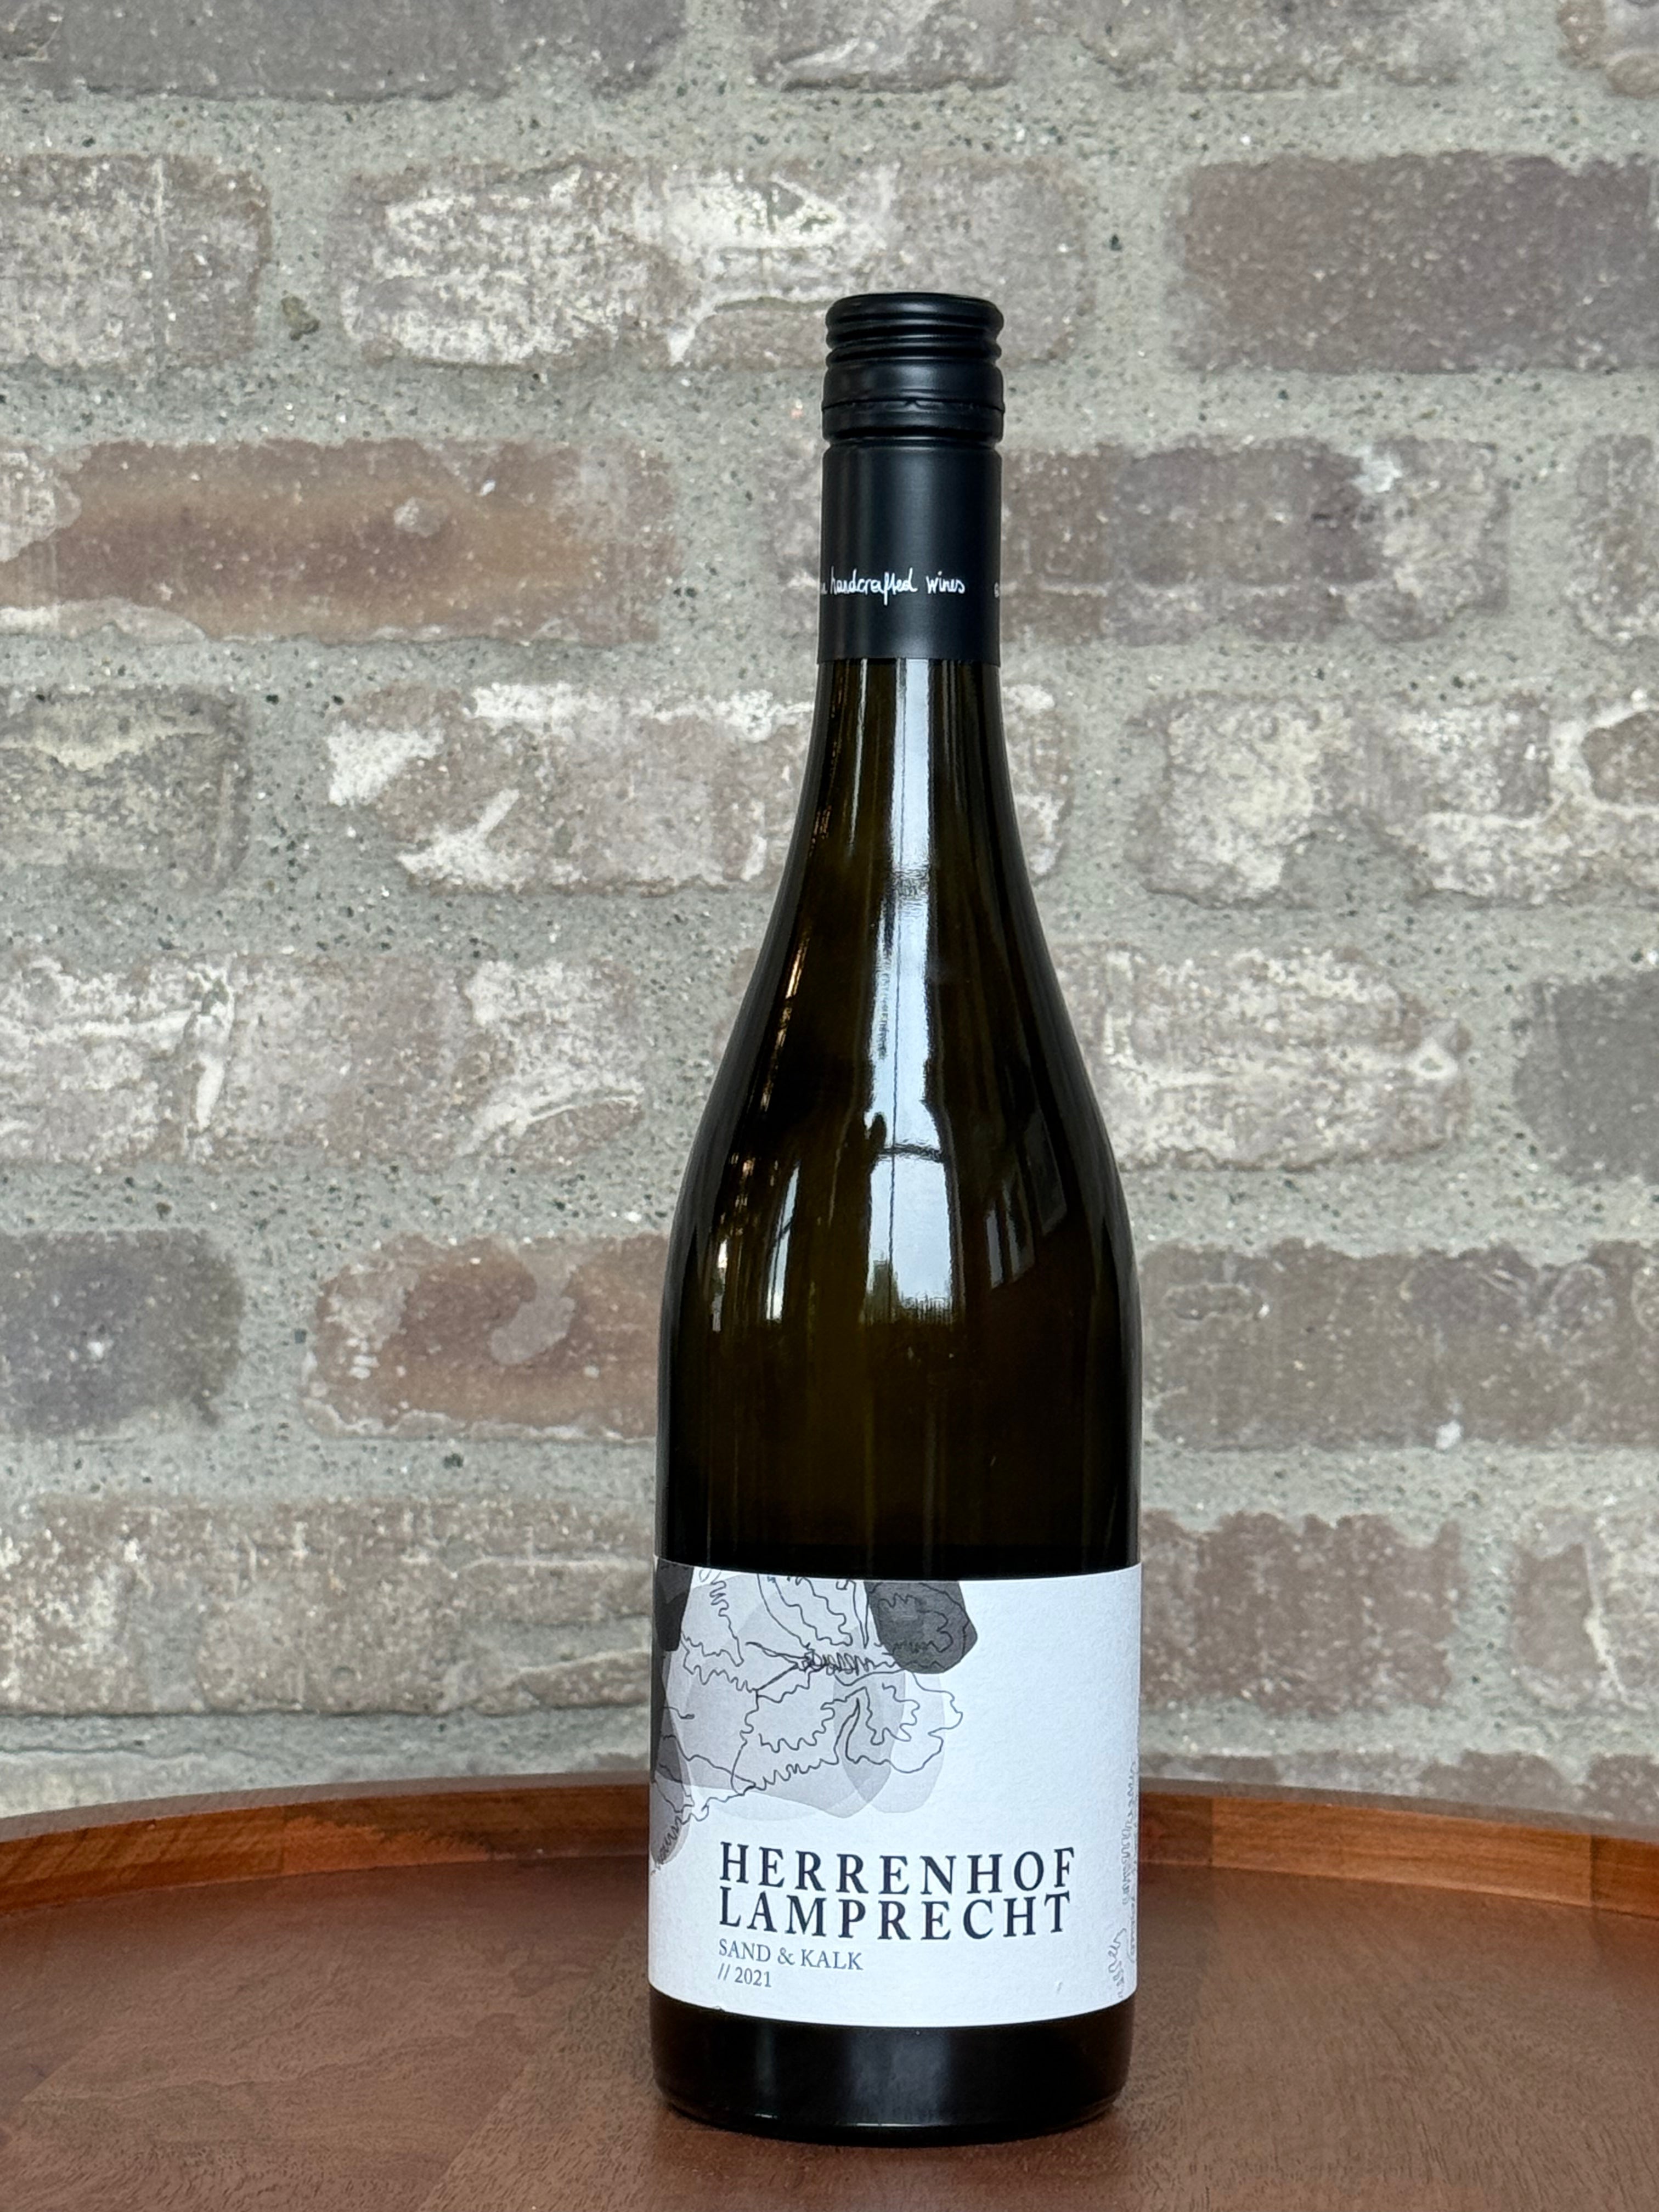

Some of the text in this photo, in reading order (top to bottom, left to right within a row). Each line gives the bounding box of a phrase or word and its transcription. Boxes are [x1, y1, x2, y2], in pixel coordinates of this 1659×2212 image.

[830, 566, 918, 606] handcrafted
[926, 571, 966, 594] wines
[719, 1841, 1075, 1895] HERRENHOF
[719, 1885, 1071, 1941] LAMPRECHT
[719, 1938, 864, 1971] SAND & KALK
[734, 1966, 772, 1988] 2021
